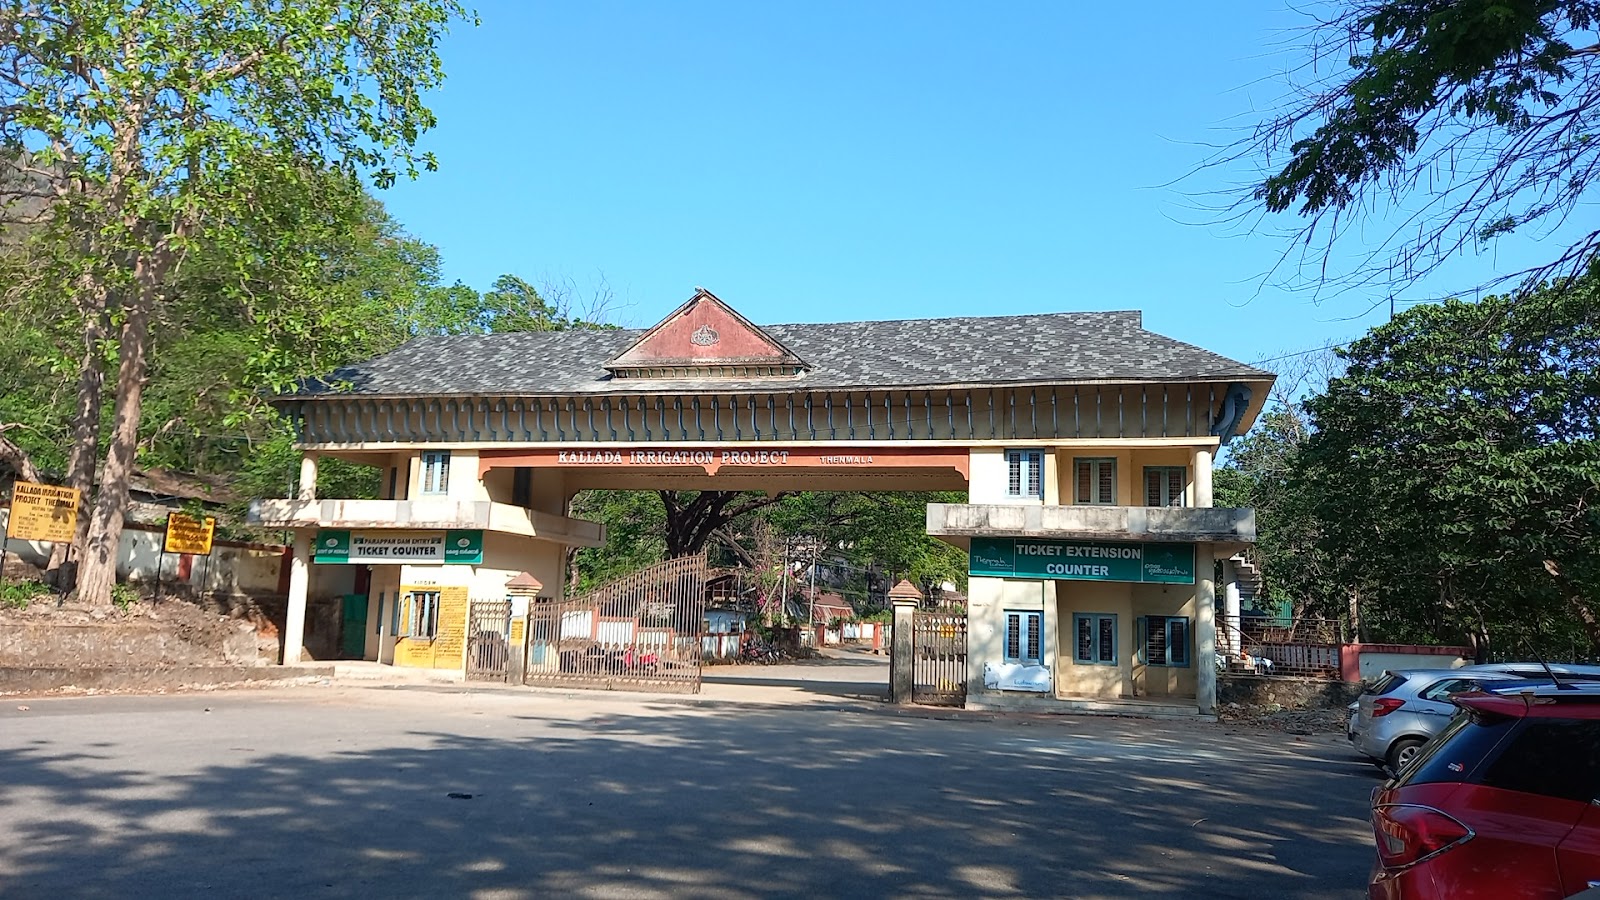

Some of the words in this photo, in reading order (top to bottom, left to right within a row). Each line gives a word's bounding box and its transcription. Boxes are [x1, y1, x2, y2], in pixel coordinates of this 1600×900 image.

[558, 451, 623, 465] KALLADA
[629, 451, 714, 465] IRRIGATION
[720, 451, 789, 465] PROJECT
[820, 456, 873, 465] THENMALA
[15, 494, 41, 505] PROJECT
[357, 546, 390, 556] TICKET
[392, 546, 436, 556] COUNTER
[1015, 544, 1063, 556] TICKET
[1066, 546, 1141, 560] EXTENSION
[1046, 563, 1109, 576] COUNTER
